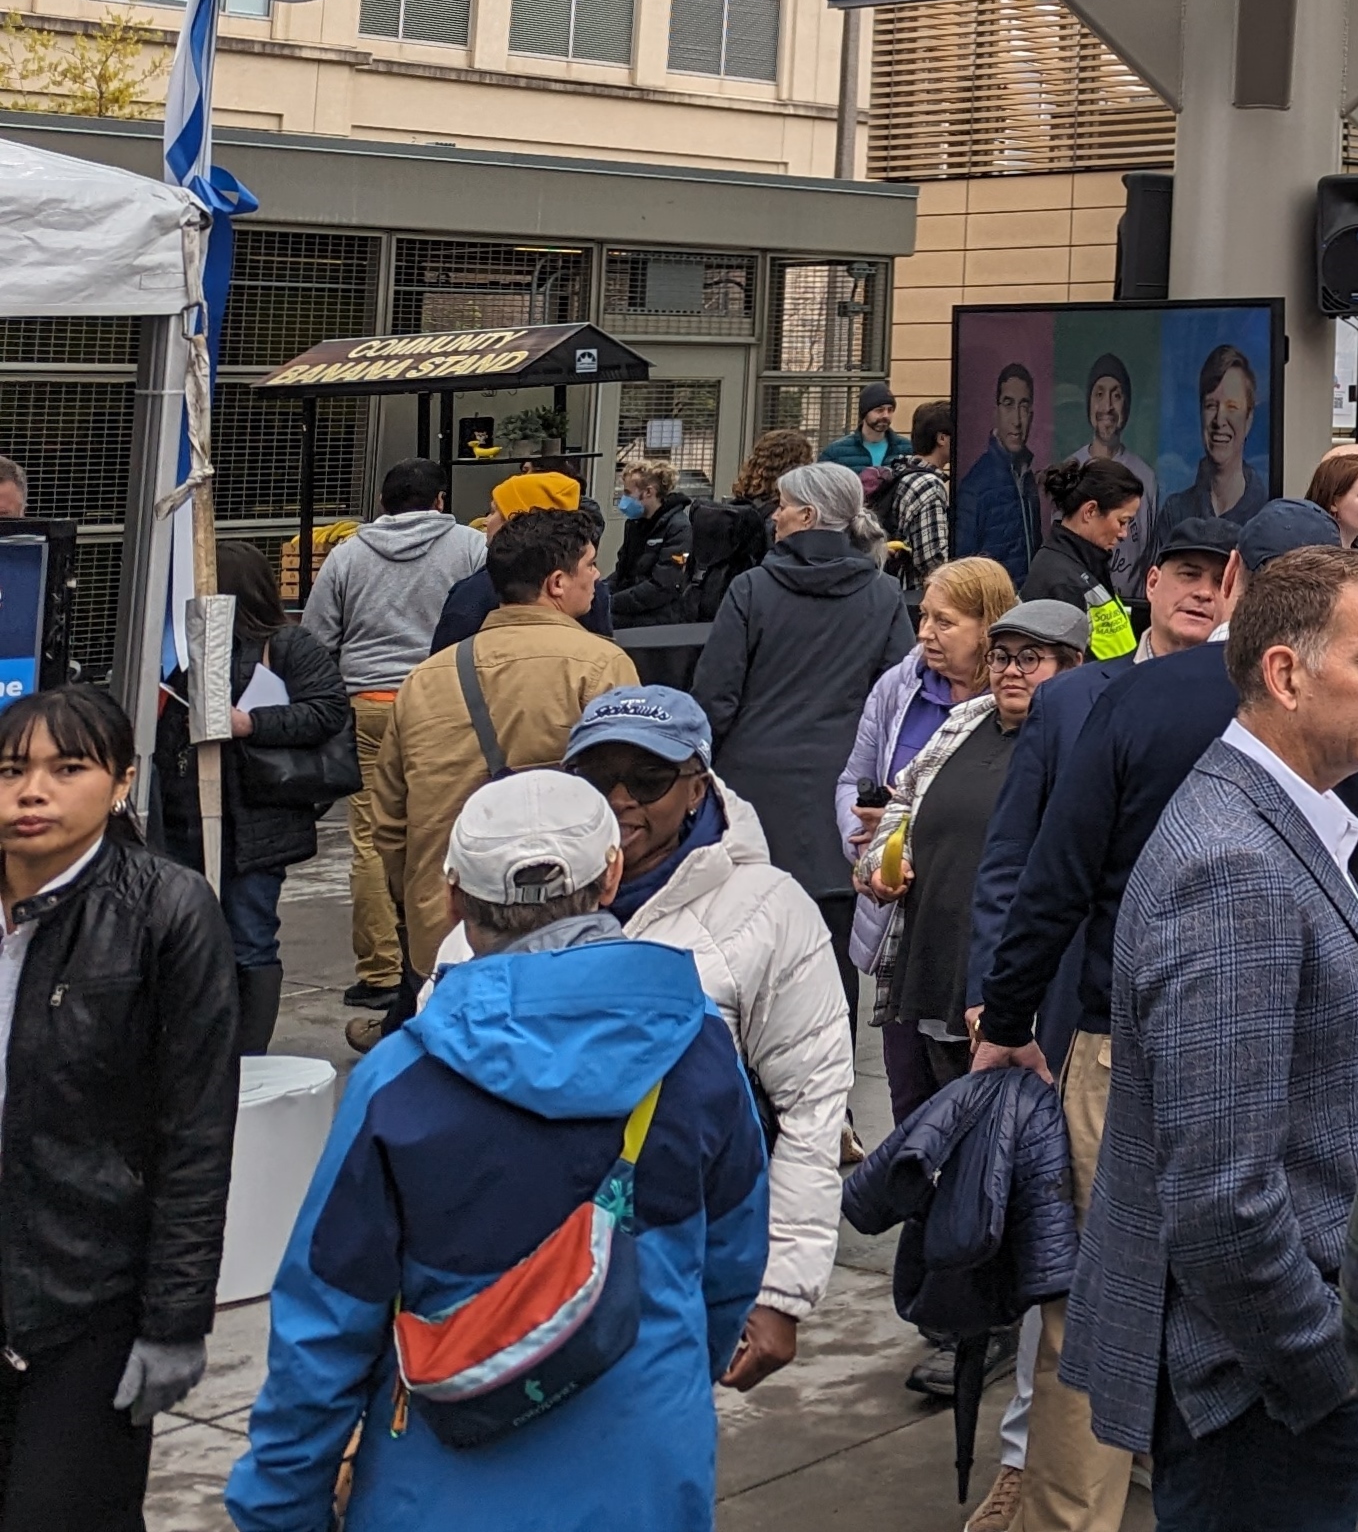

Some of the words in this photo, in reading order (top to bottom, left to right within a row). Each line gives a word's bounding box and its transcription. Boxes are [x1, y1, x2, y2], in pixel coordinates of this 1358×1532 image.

[348, 330, 529, 359] COMMUNITY
[266, 358, 414, 385] BANANA
[405, 350, 530, 378] STAND
